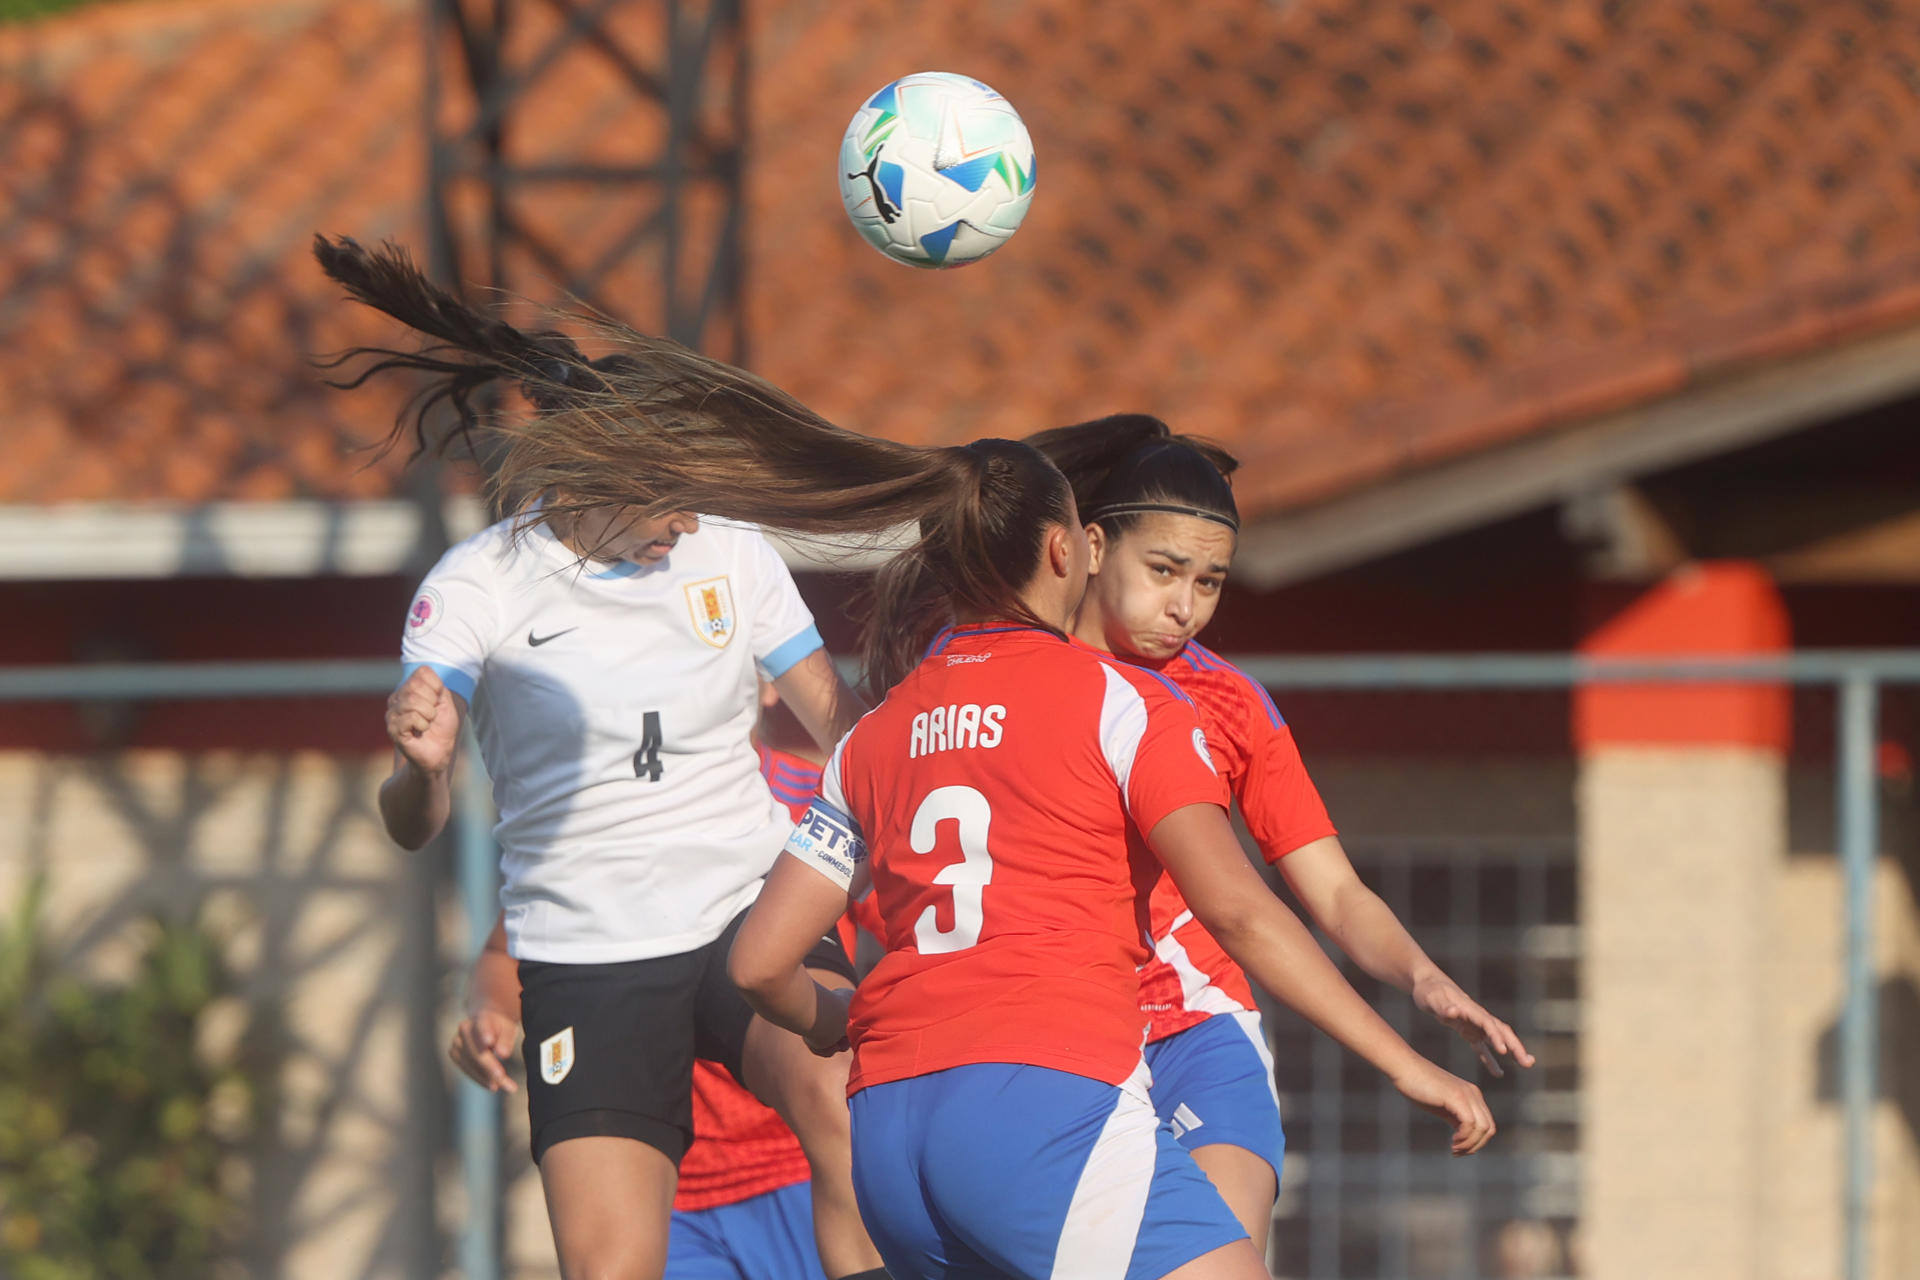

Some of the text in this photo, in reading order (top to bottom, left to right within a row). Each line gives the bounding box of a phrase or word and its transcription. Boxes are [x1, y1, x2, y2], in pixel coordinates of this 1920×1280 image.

[633, 711, 663, 782] 4
[909, 704, 1007, 759] ARIAS
[910, 785, 993, 955] 3
